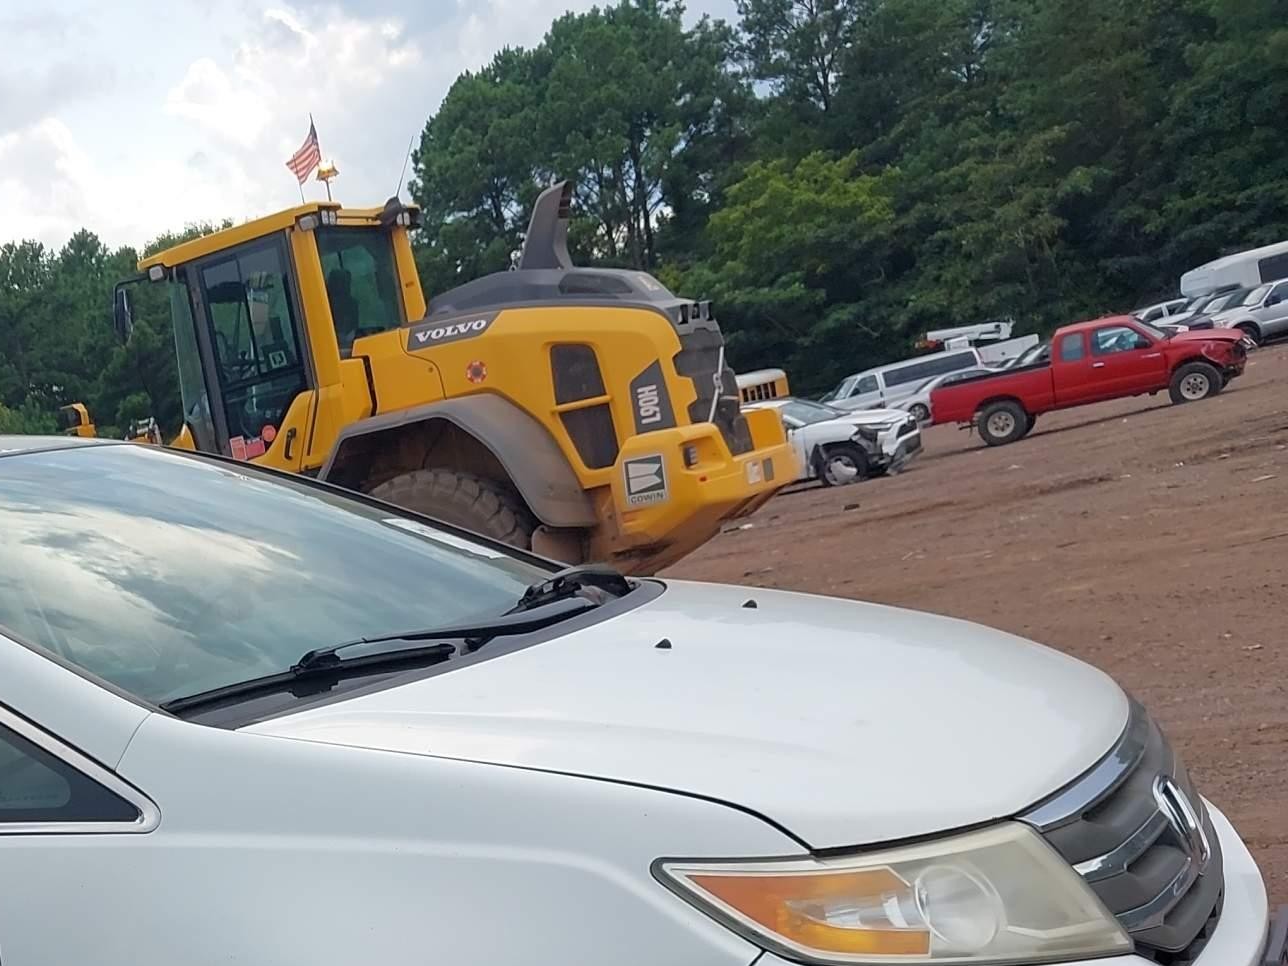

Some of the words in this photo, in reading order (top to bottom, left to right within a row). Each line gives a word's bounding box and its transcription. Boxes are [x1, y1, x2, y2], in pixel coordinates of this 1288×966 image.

[415, 319, 487, 343] VOLVO
[636, 384, 662, 425] L90H
[630, 492, 665, 504] COWIN
